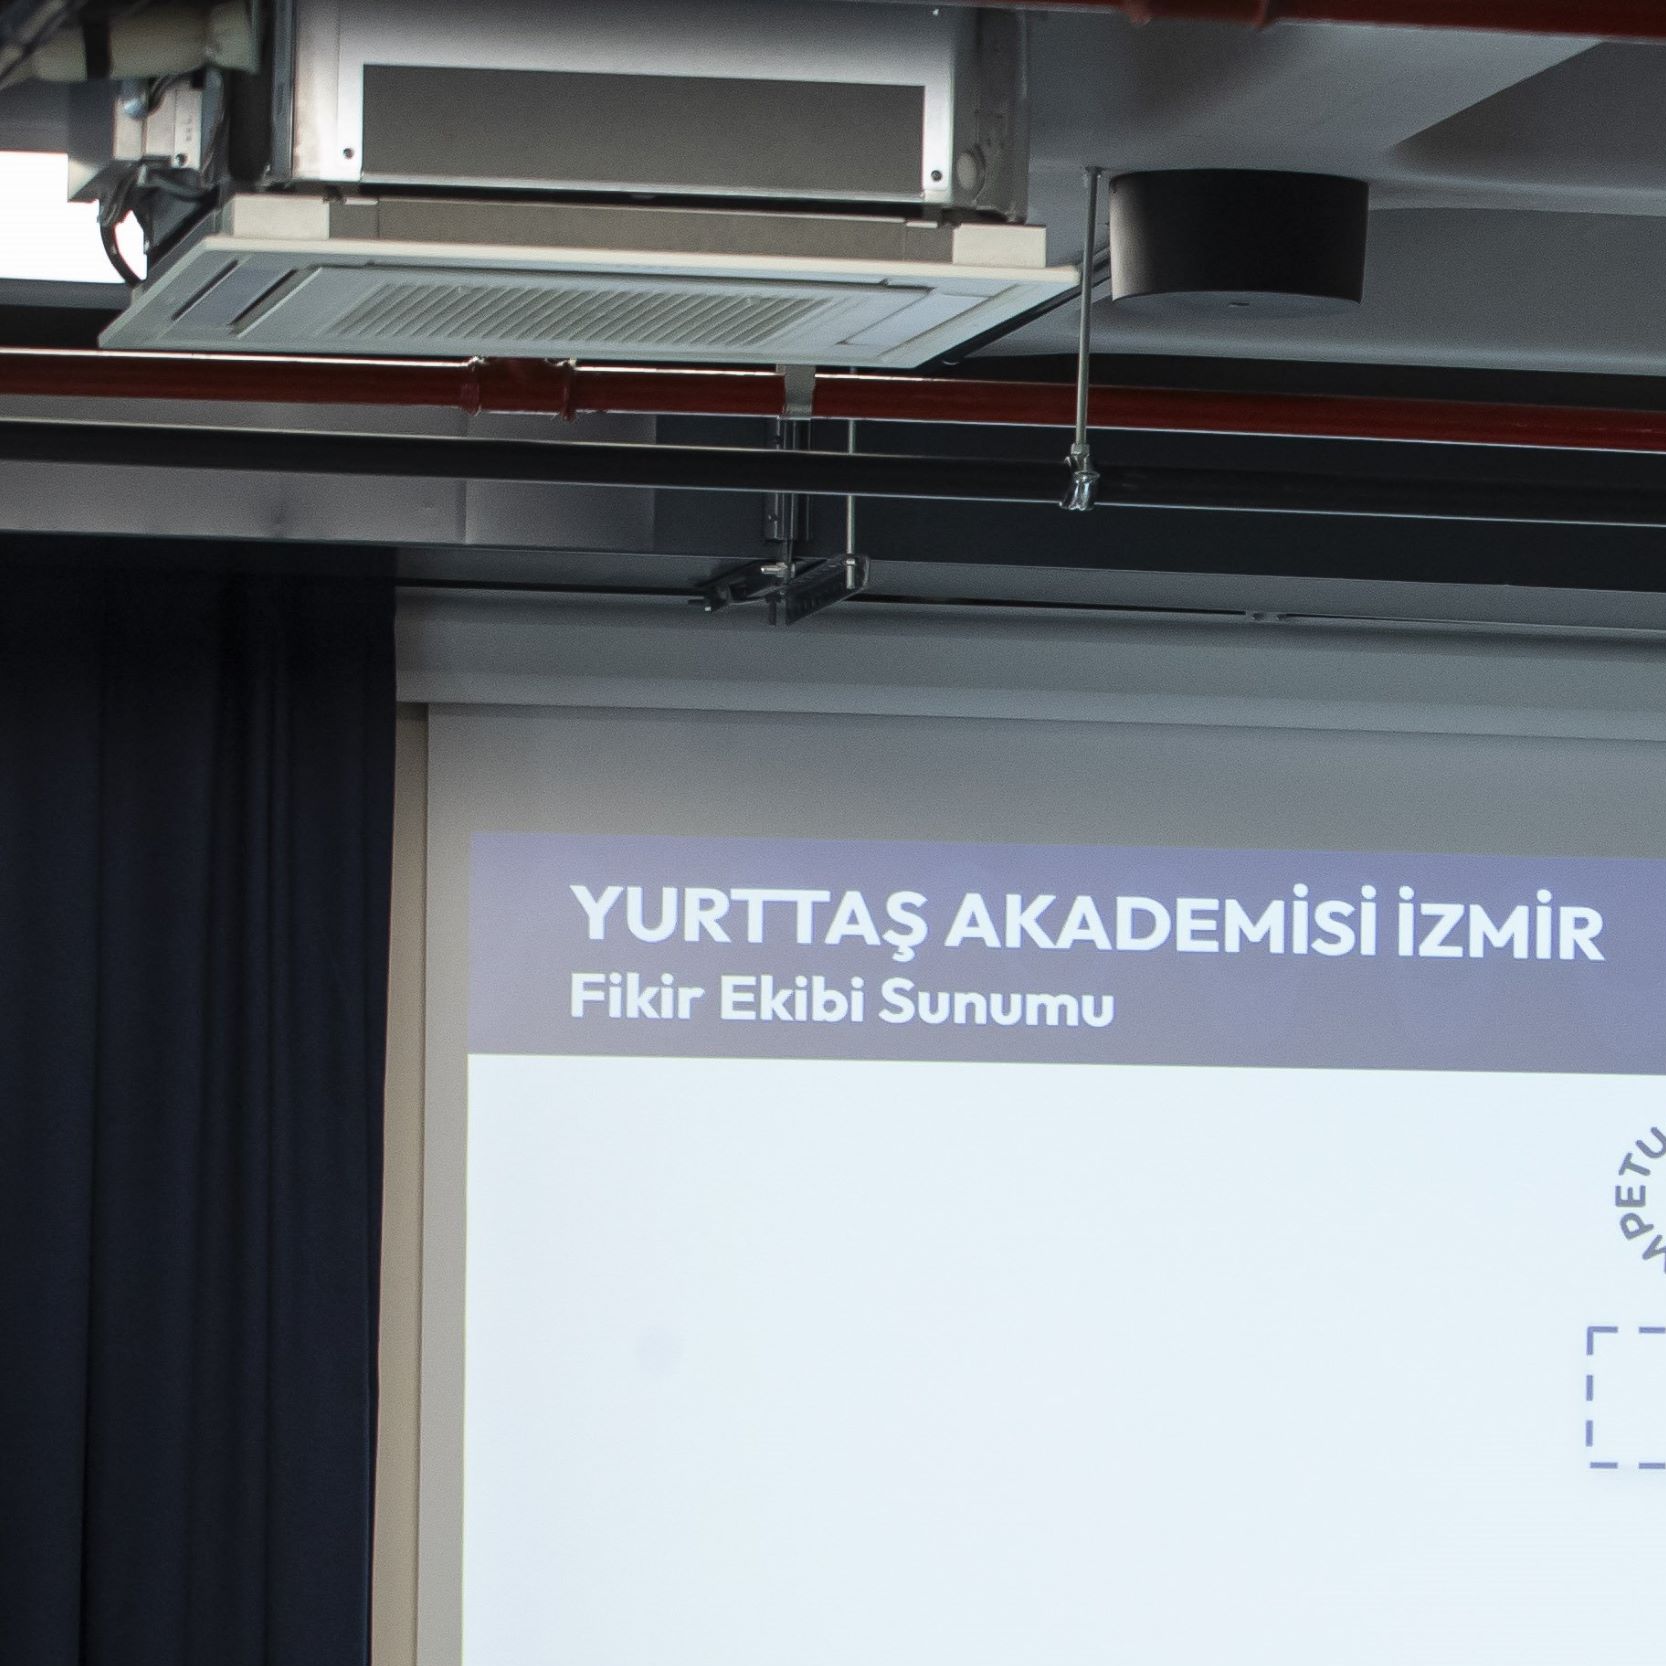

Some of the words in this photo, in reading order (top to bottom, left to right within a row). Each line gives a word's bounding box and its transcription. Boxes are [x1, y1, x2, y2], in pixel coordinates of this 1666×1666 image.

[569, 884, 928, 963] YURTTAŞ
[944, 883, 1377, 957] AKADEMİSİ
[1398, 885, 1606, 961] İZMİR
[571, 972, 706, 1020] Fikir
[720, 974, 865, 1023] Ekibi
[878, 977, 1114, 1028] Sunumu
